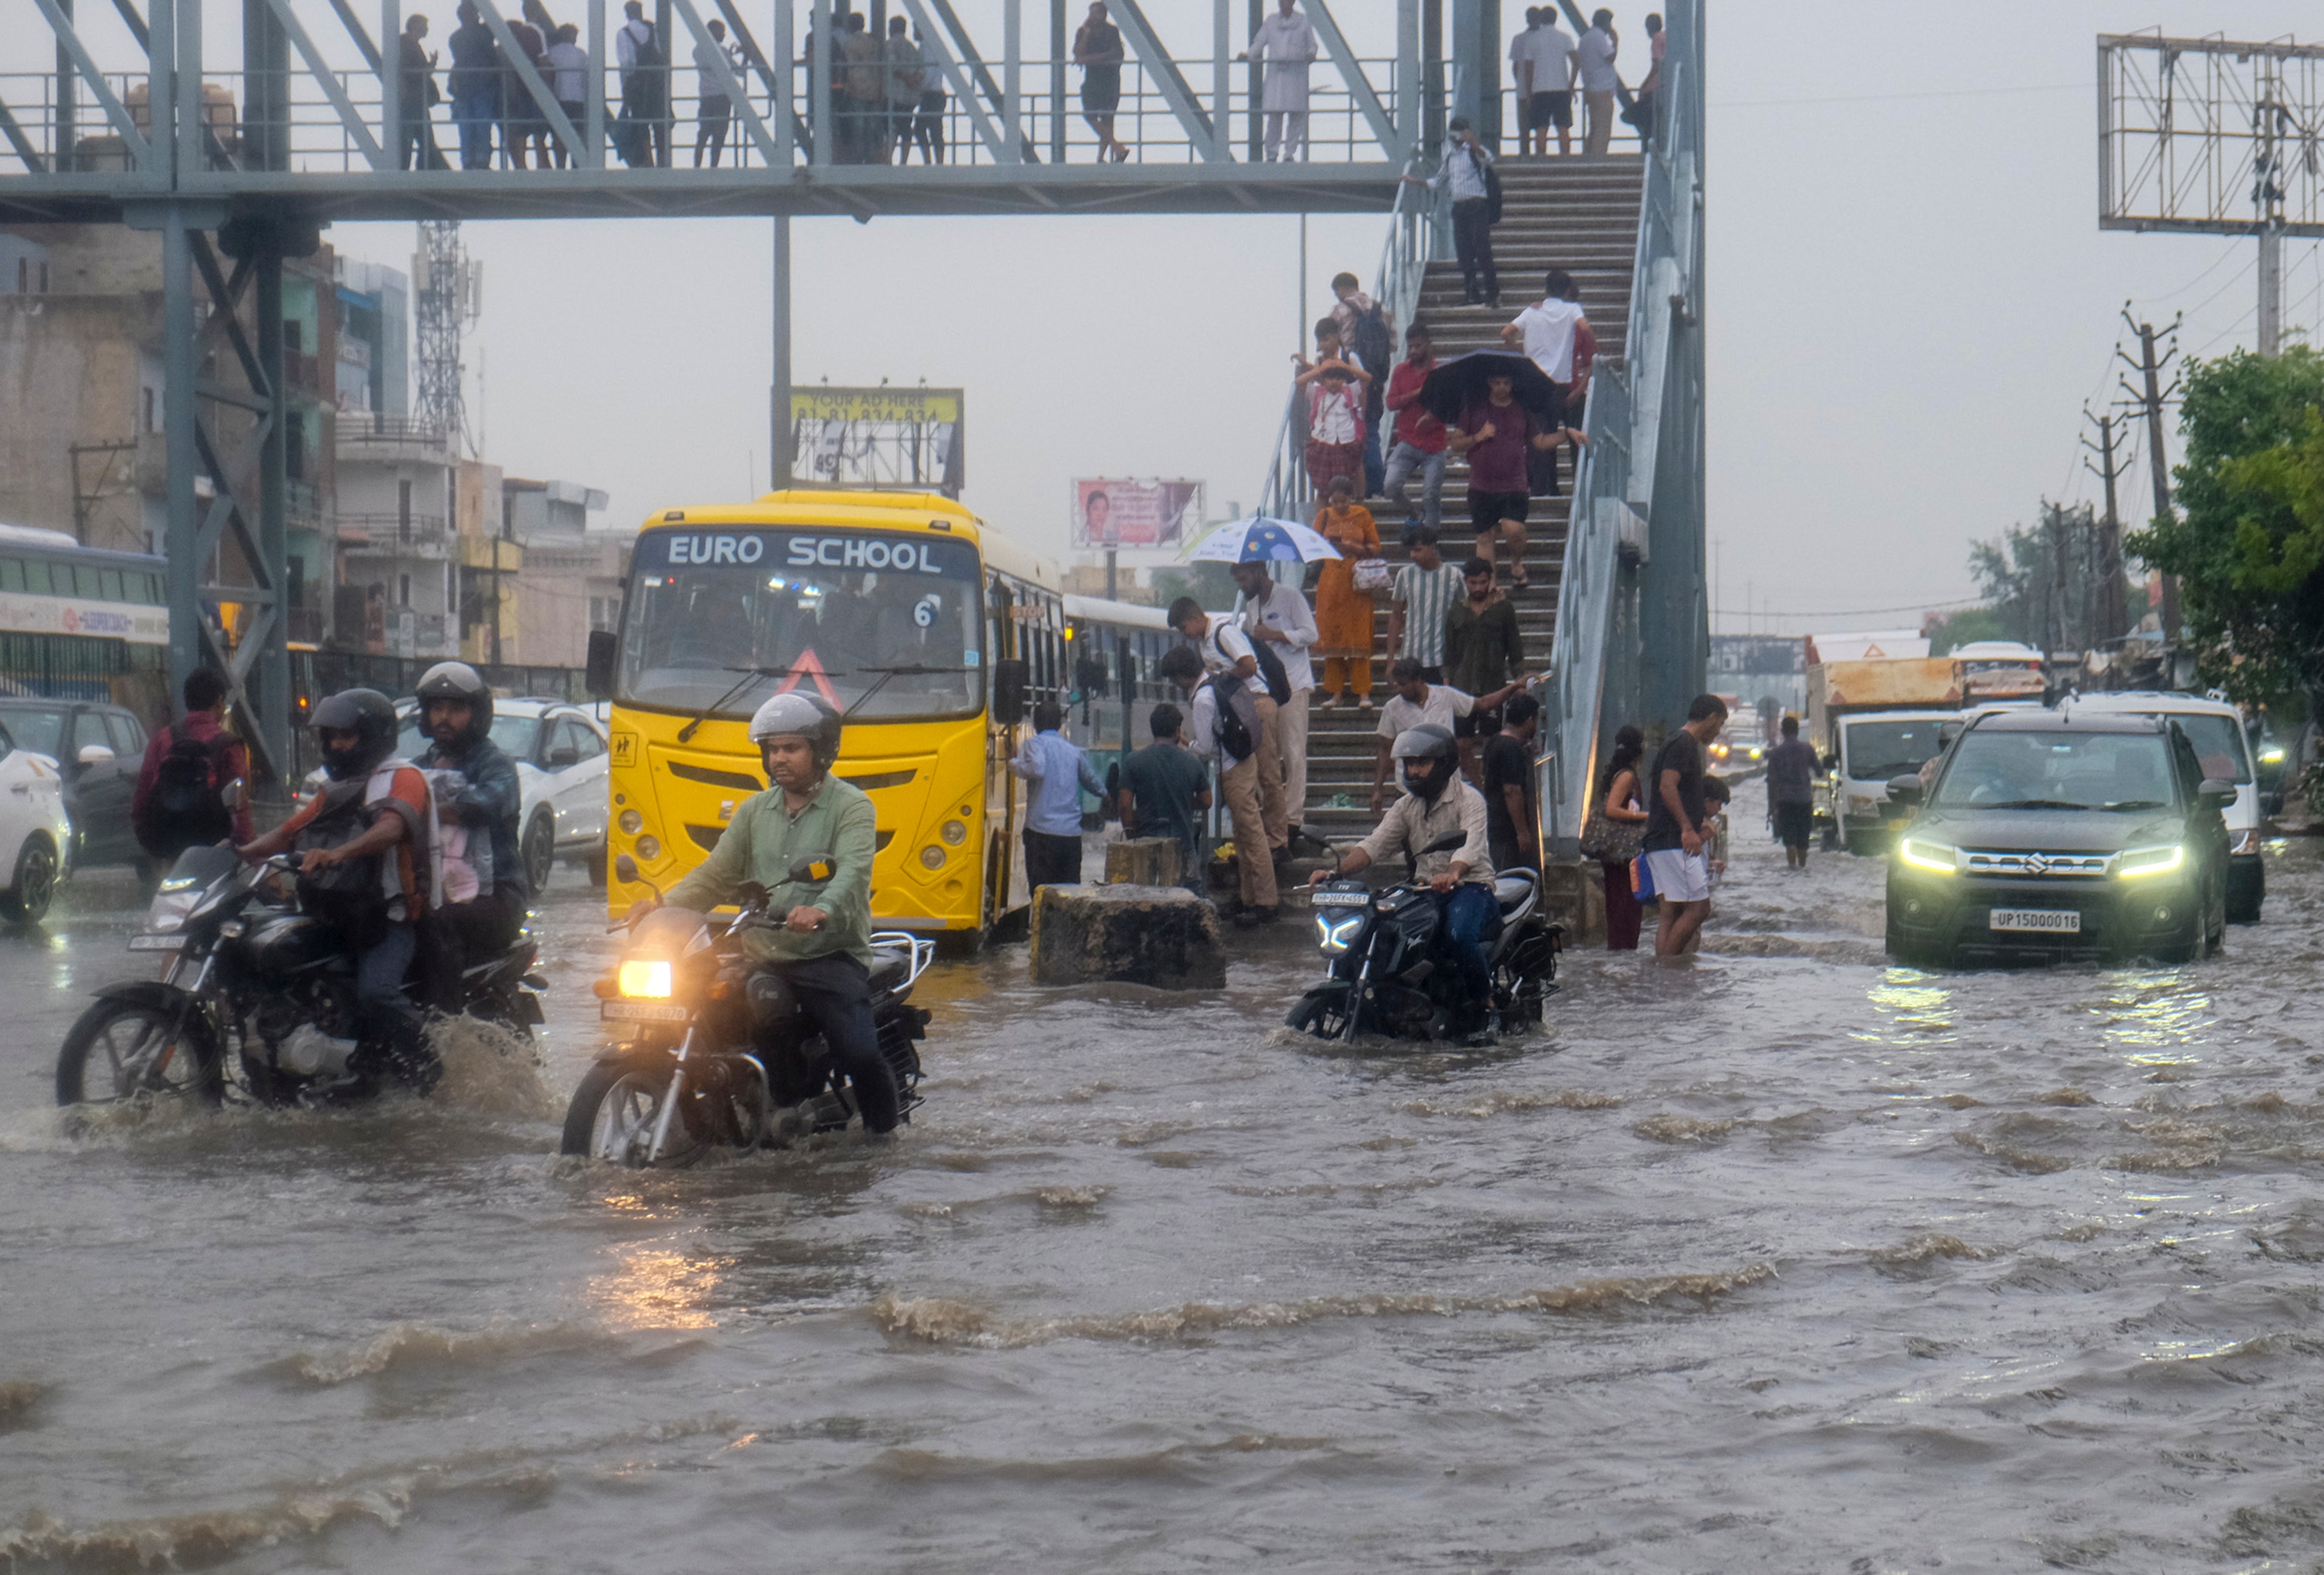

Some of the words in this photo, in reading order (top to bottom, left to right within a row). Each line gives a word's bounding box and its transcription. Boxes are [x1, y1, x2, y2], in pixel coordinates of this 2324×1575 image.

[810, 394, 854, 407] YOUR
[860, 393, 882, 407] AD
[888, 394, 925, 408] HERE
[668, 535, 764, 564] EURO
[787, 537, 942, 573] SCHOOL
[914, 600, 931, 627] 6
[1013, 606, 1045, 618] STOP
[1998, 913, 2078, 928] UP15DQ0016
